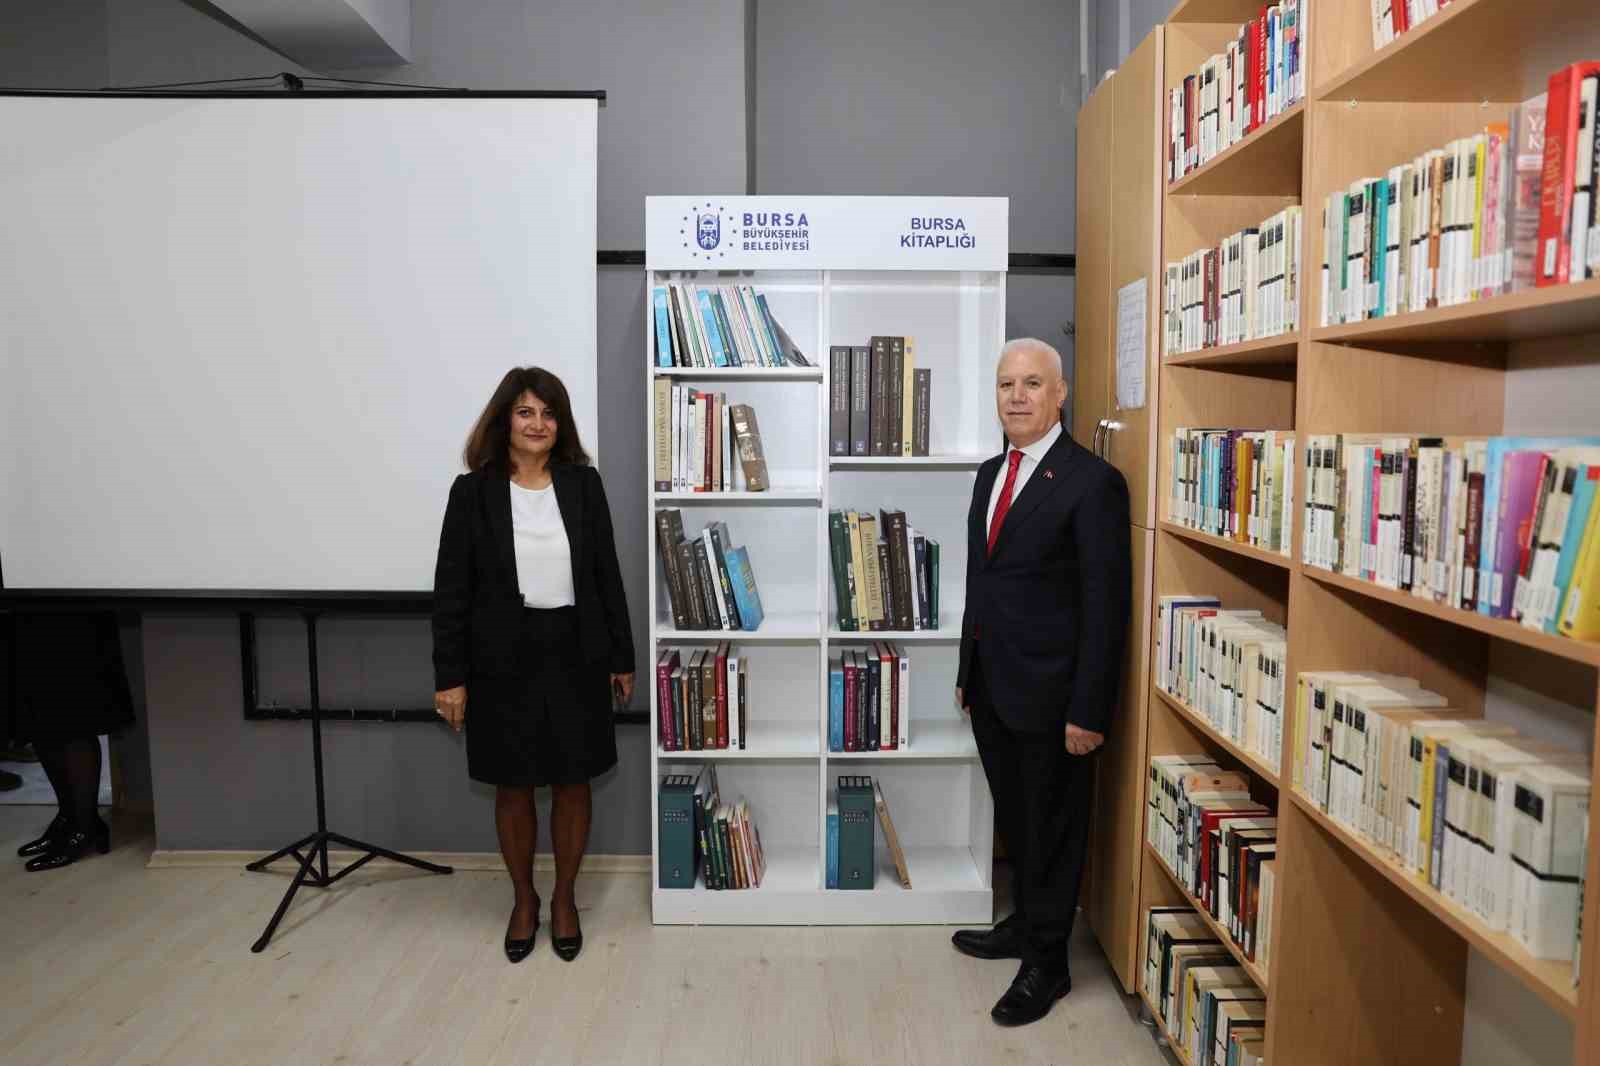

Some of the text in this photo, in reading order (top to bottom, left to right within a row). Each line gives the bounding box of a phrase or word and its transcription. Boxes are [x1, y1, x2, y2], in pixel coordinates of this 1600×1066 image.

[743, 213, 809, 226] BURSA
[911, 217, 966, 231] BURSA
[743, 227, 809, 240] BÜYÜKŞEHİR
[900, 232, 976, 248] KİTAPLIĞI
[743, 239, 809, 251] BELEDİYESİ
